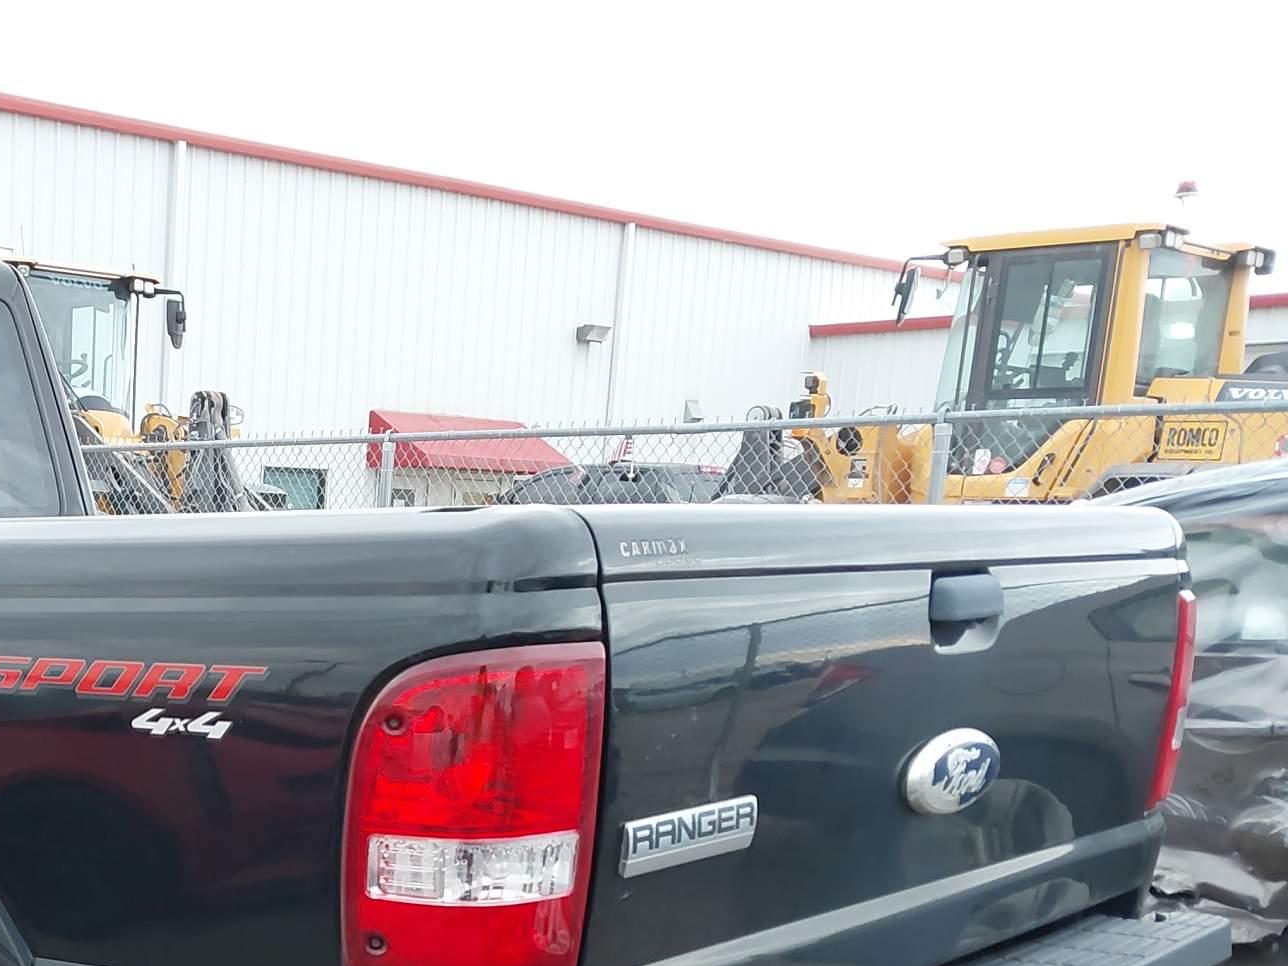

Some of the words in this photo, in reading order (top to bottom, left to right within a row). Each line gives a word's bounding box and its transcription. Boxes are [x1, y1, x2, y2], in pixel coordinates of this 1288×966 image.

[1166, 427, 1220, 447] ROMCO
[130, 707, 233, 740] 4x4
[631, 802, 755, 855] RANGER
